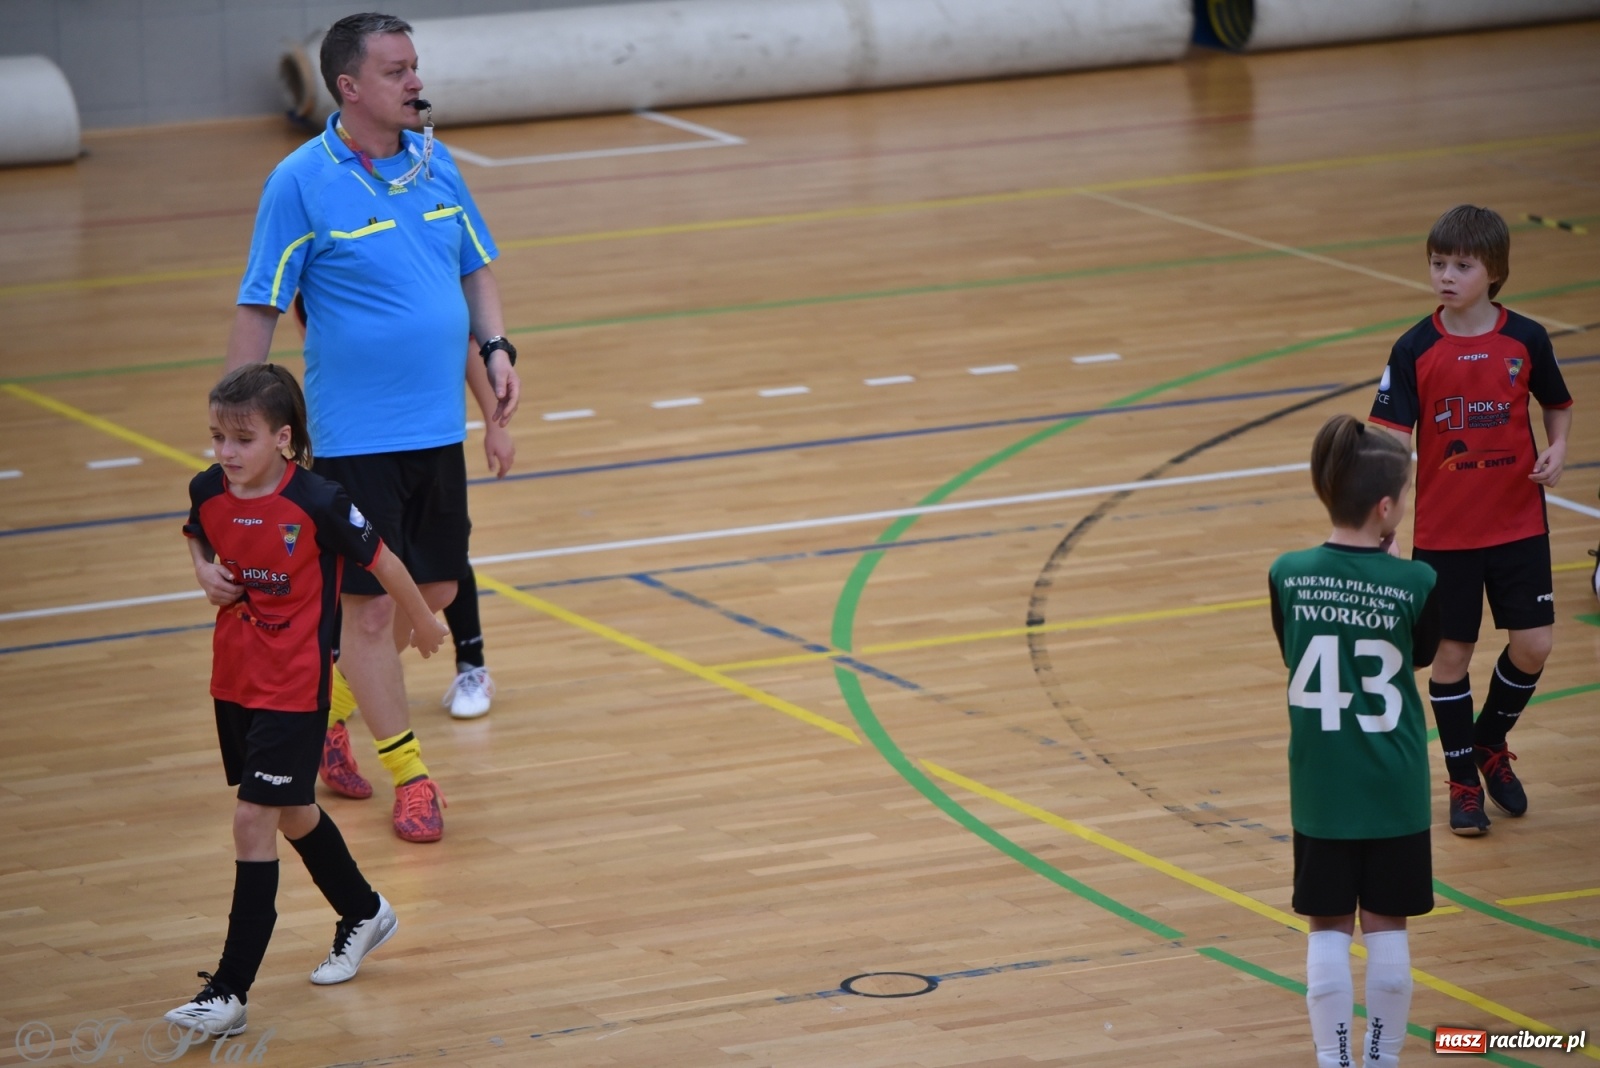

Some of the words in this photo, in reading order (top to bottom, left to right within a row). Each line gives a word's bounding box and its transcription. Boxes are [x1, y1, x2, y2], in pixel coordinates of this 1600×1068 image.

[1457, 353, 1489, 362] regio
[1468, 401, 1495, 413] HDK
[233, 517, 263, 526] regio
[242, 568, 269, 580] HDK
[1284, 575, 1343, 589] AKADEMIA
[1292, 604, 1400, 631] TWORKÓW
[1288, 635, 1403, 733] 43
[254, 771, 292, 785] regio
